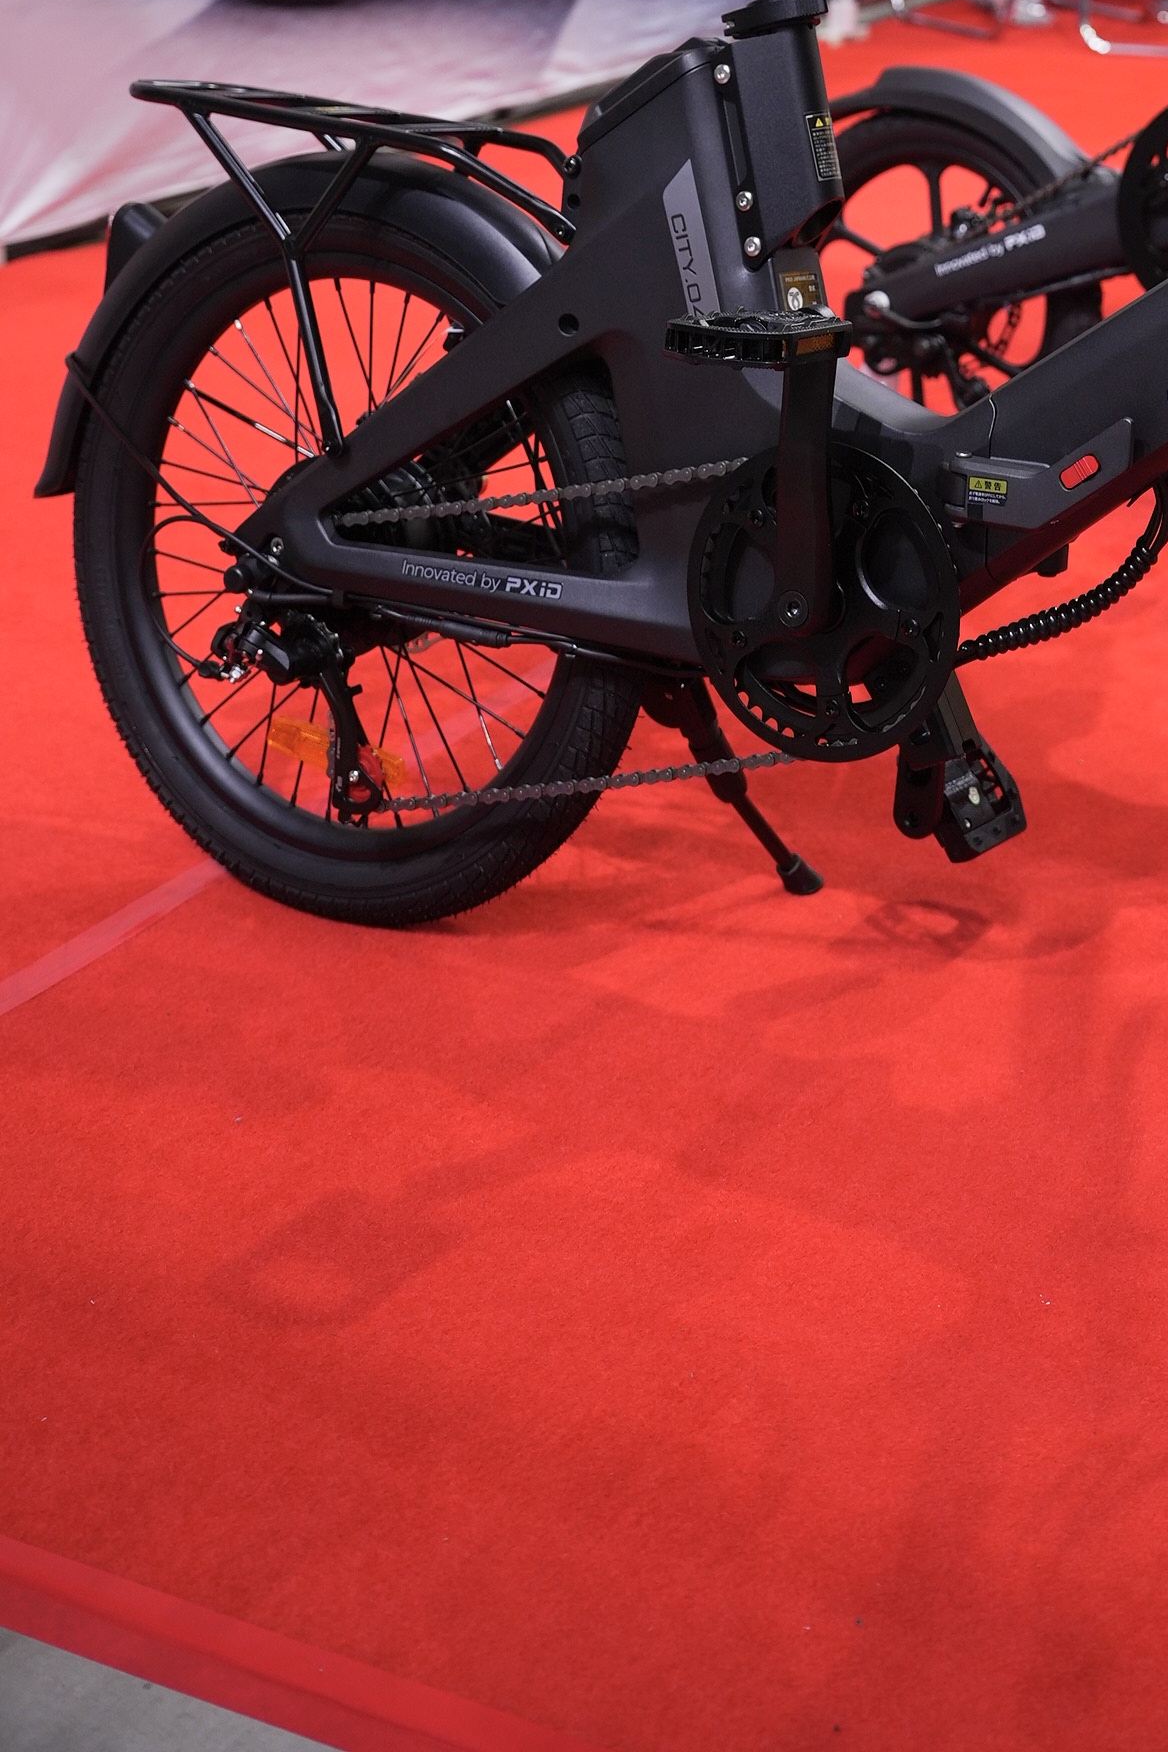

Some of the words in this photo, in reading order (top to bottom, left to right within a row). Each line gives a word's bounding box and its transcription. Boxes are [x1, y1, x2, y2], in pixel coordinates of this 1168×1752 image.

[985, 480, 1001, 491] 警告
[402, 560, 477, 586] Innovated
[480, 573, 501, 593] by
